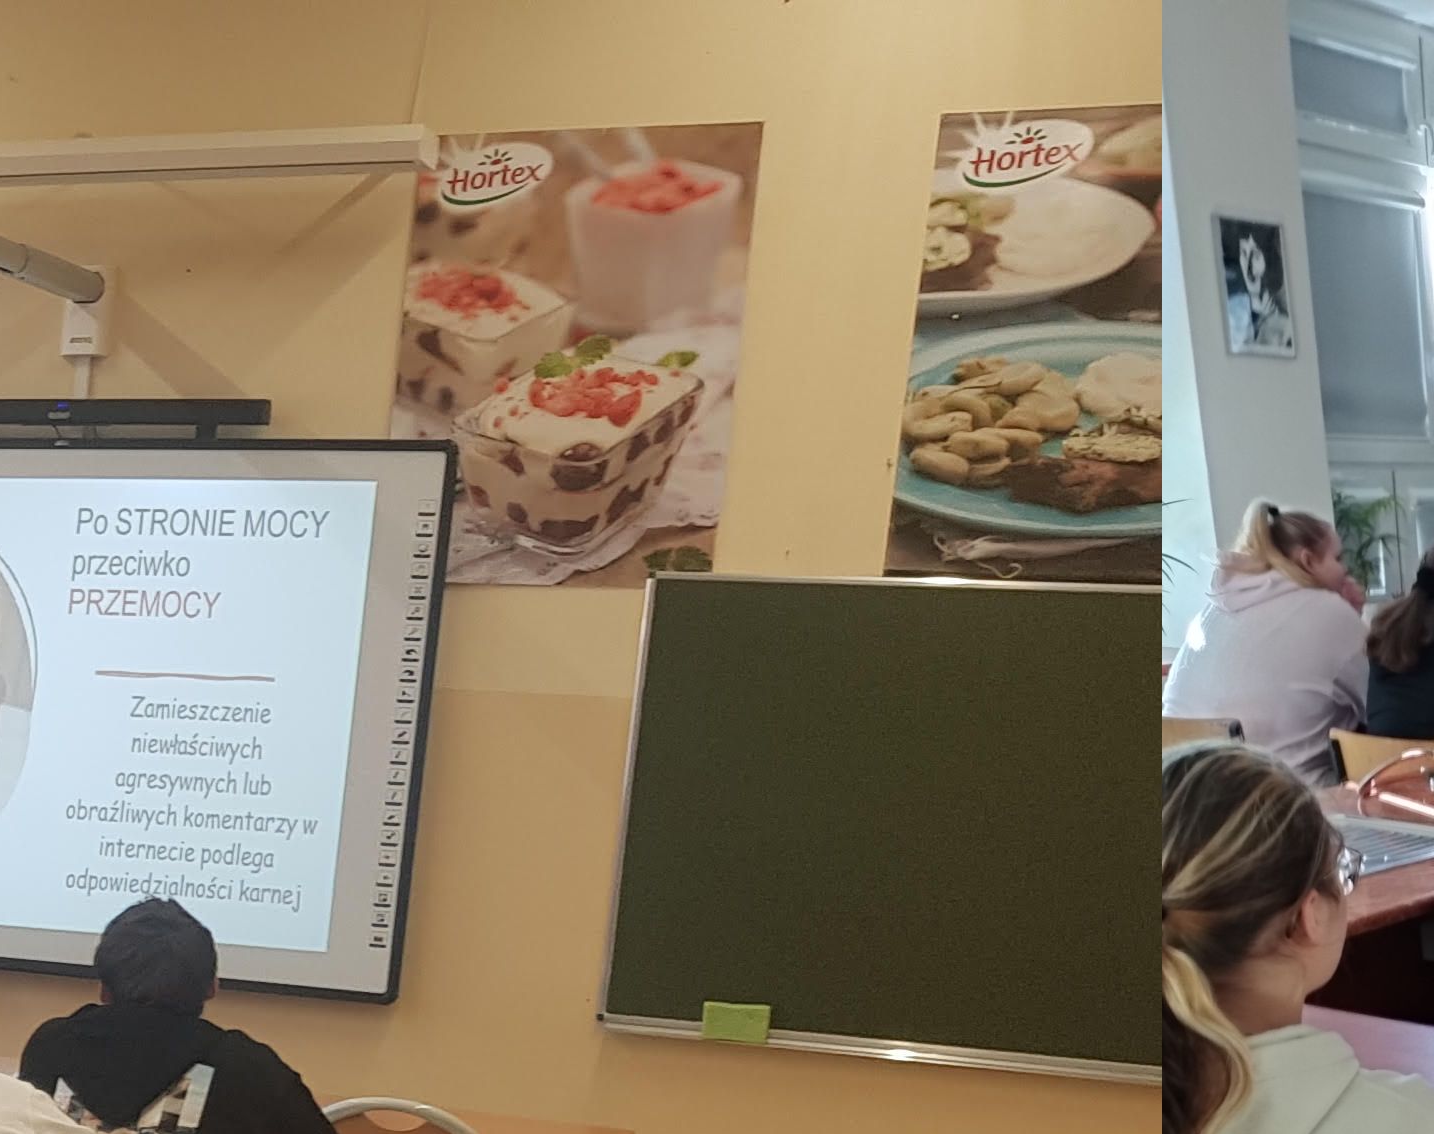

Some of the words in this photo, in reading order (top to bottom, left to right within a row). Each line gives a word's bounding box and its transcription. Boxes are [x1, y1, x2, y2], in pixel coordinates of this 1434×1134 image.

[969, 143, 1083, 177] Hortex
[446, 163, 543, 195] Hortex
[75, 507, 108, 535] Po
[115, 508, 236, 536] STRONIE
[242, 509, 330, 538] MOCY
[72, 550, 191, 581] przeciwko
[68, 588, 222, 619] PRZEMOCY
[130, 695, 272, 724] Zamieszczenie
[131, 733, 262, 765] niewłaściwych
[115, 770, 237, 799] agresywnych
[242, 772, 272, 796] lub
[65, 799, 177, 831] obraźliwych
[183, 805, 298, 840] komentarzy
[303, 819, 318, 835] w
[99, 835, 195, 862] internecie
[200, 843, 275, 874] podlega
[65, 868, 233, 900] odpowiedzialności
[239, 880, 302, 913] karnej
